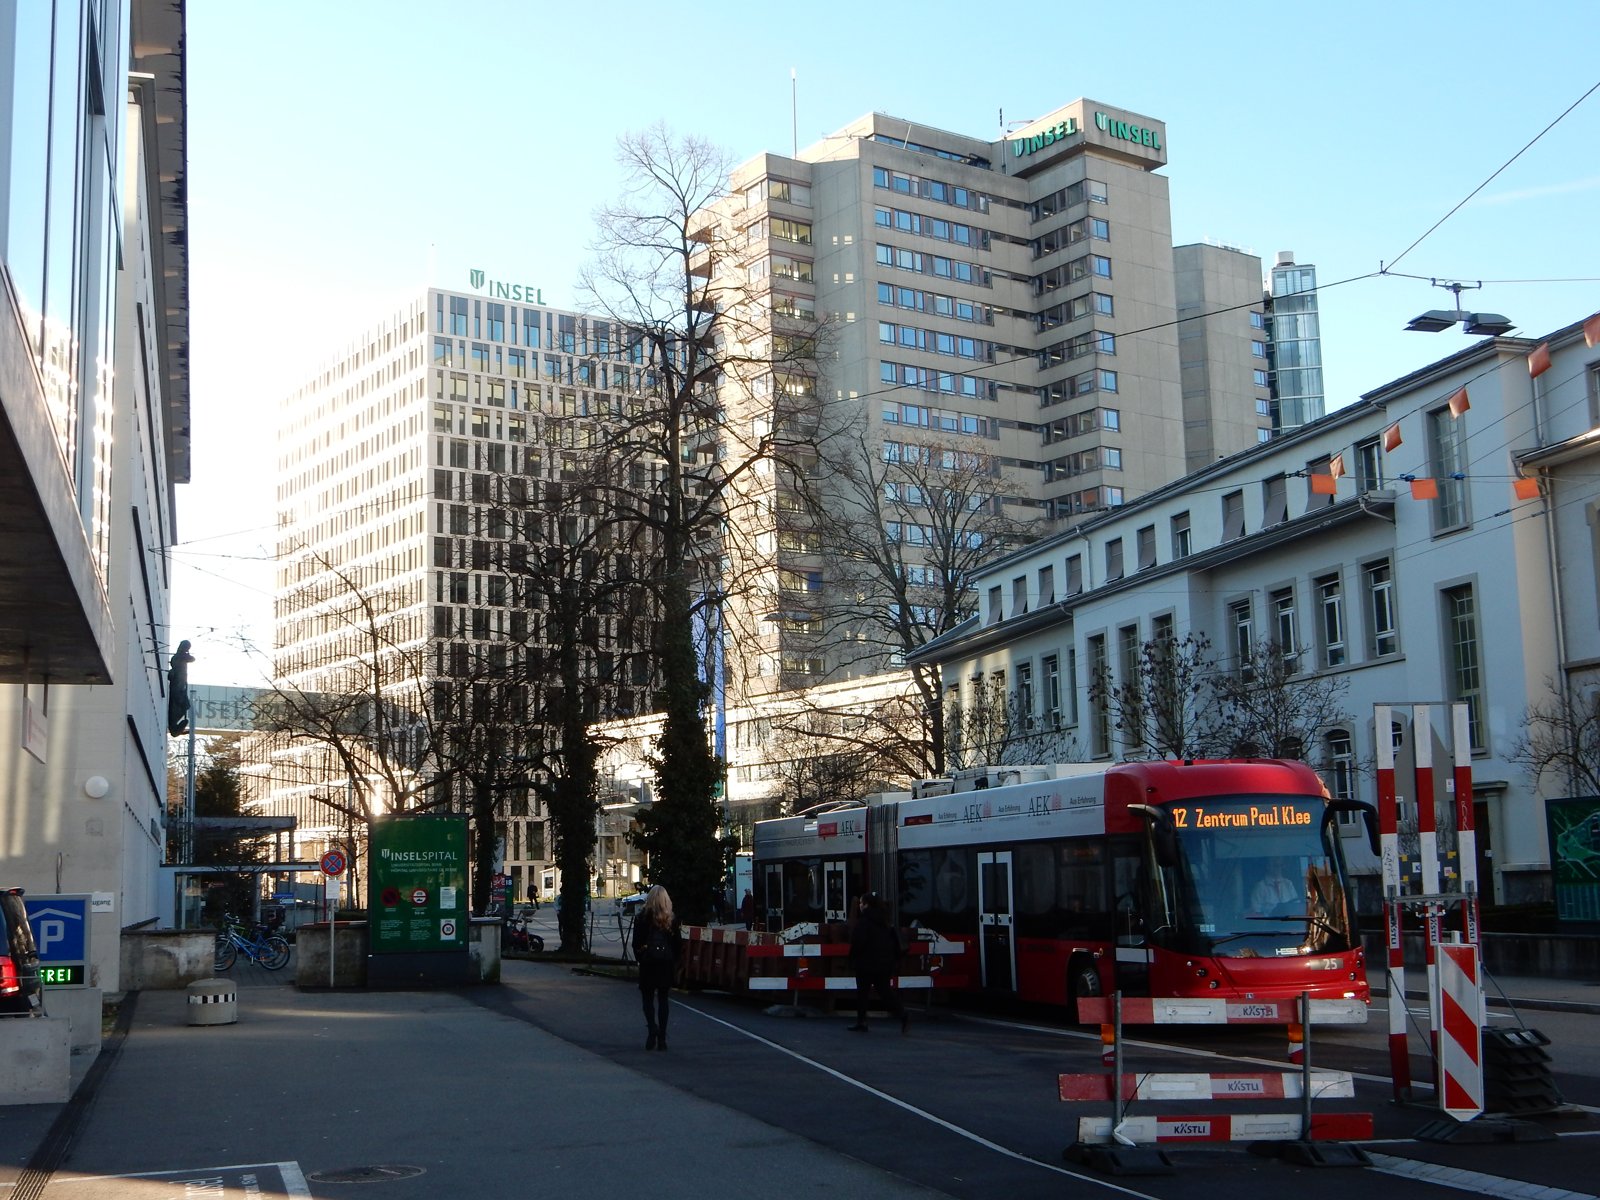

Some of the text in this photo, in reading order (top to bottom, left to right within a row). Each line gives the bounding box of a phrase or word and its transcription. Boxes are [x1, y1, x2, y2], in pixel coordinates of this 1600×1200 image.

[1026, 117, 1078, 155] INSEL
[1109, 118, 1161, 150] INSEL
[489, 279, 547, 305] INSEL
[963, 803, 982, 824] AEK
[1028, 795, 1051, 817] AEK
[1172, 806, 1311, 828] 12 Zentrum Paul Klee
[390, 851, 458, 861] INSELSPITAL
[92, 899, 111, 907] ugang
[40, 919, 65, 954] P
[1323, 958, 1338, 970] 25
[1227, 1080, 1259, 1092] KÄSTLI
[1173, 1123, 1206, 1134] KÄSTLI
